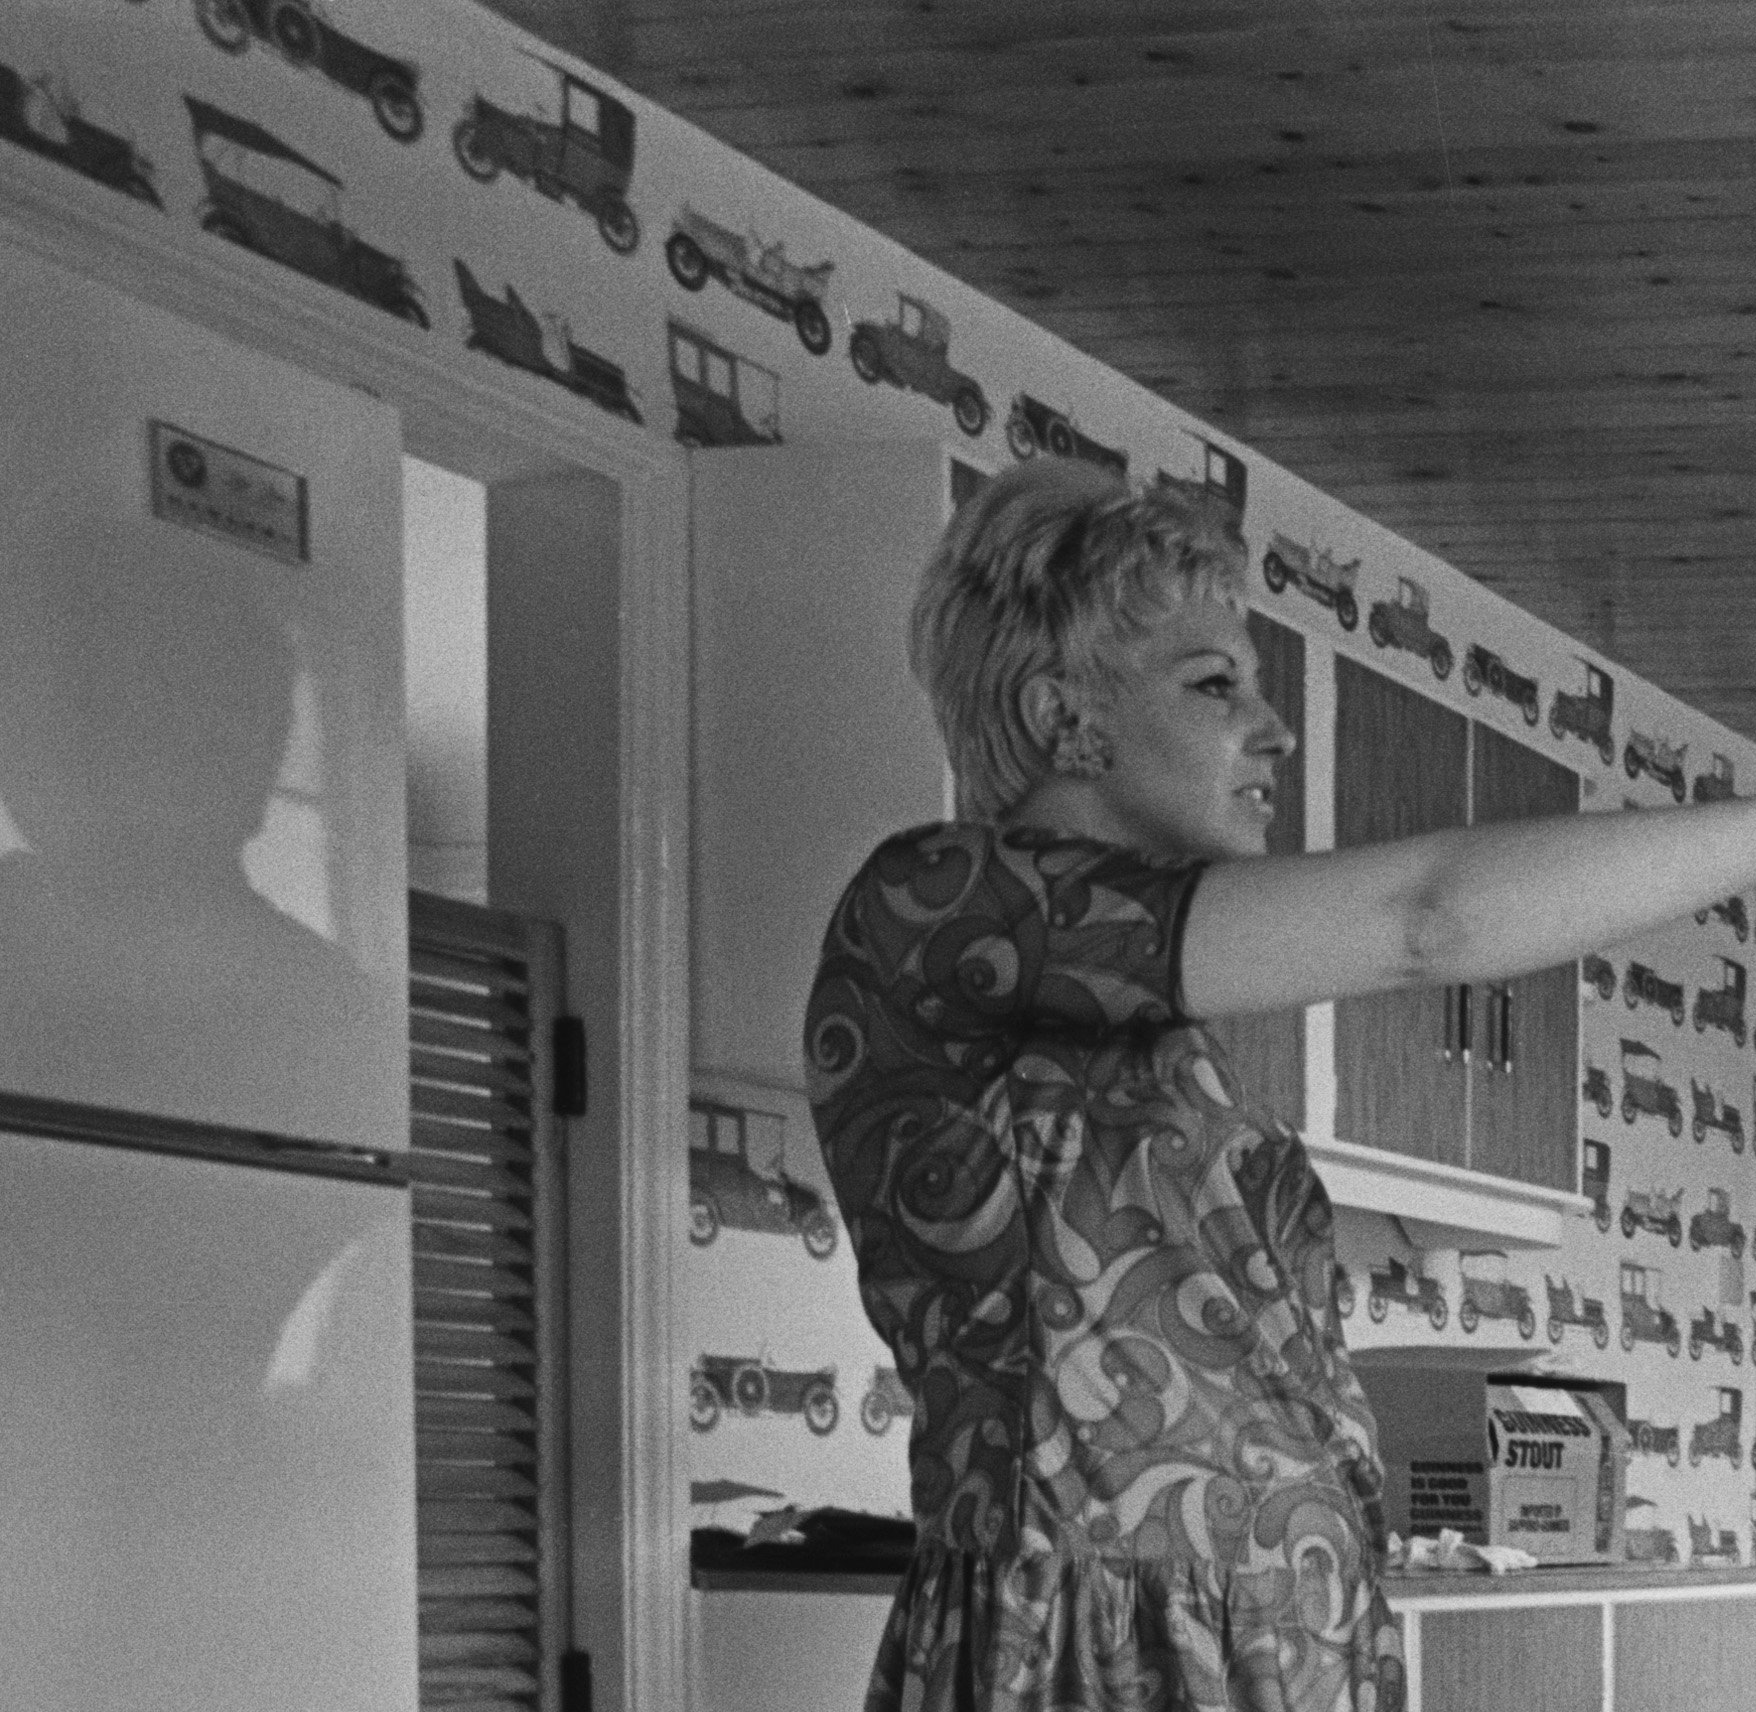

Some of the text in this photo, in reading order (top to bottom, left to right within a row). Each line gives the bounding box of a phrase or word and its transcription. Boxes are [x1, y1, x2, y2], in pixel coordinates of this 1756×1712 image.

[1494, 1409, 1591, 1437] GUINNESS
[1505, 1441, 1565, 1469] STOUT
[1428, 1477, 1468, 1491] GOOD
[1410, 1493, 1472, 1507] FOR YOU
